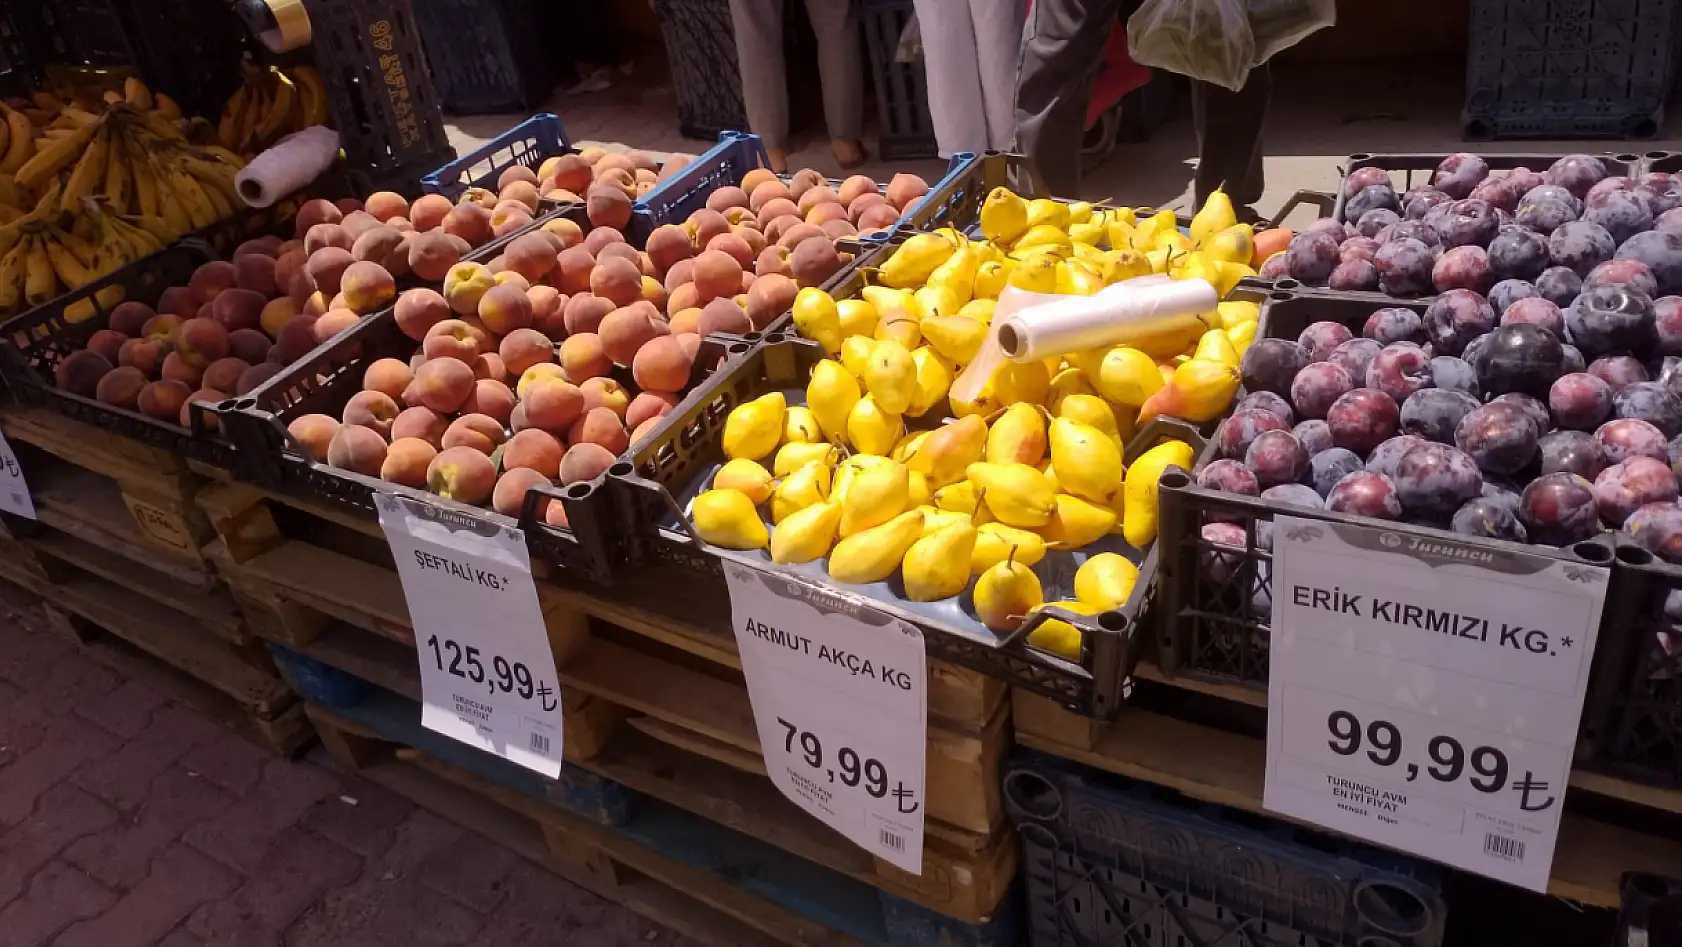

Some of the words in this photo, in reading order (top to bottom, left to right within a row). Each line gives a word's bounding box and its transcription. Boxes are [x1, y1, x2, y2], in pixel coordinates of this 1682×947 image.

[1408, 537, 1494, 562] Turuncu
[414, 549, 474, 582] ŞEFTALİ
[1293, 585, 1362, 616] ERİK
[1372, 598, 1489, 642] KIRMIZI
[745, 616, 811, 654] ARMUT
[818, 645, 875, 679] AKÇA
[882, 665, 911, 690] KG
[1327, 775, 1379, 797] TURUNCU
[1382, 791, 1407, 805] AVM
[1333, 787, 1347, 798] EN
